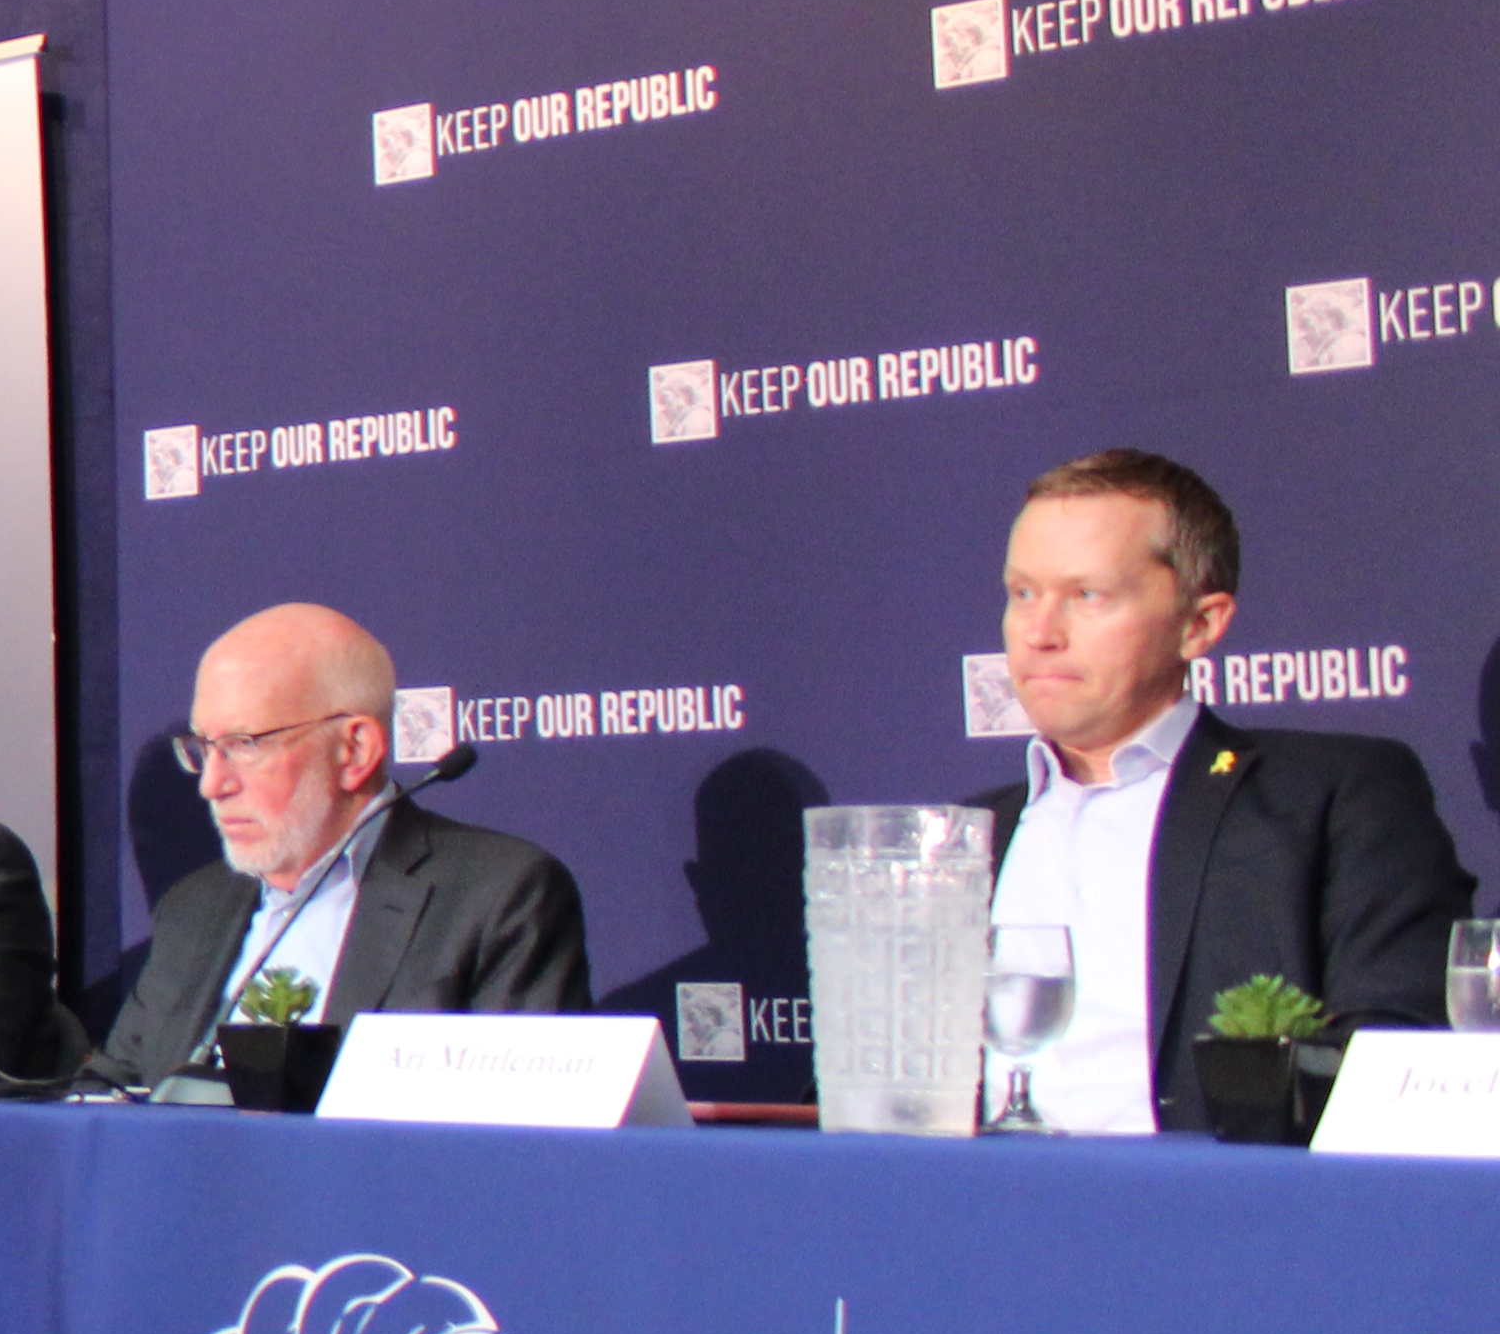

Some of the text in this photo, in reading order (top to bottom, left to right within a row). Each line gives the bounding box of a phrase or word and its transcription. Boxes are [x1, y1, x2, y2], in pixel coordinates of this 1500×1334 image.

[436, 66, 715, 156] KEEP OUR REPUBLIC
[1380, 281, 1483, 343] KEEP
[721, 336, 1036, 417] KEEP OUR REPUBLIC
[202, 407, 455, 476] KEEP OUR REPUBLIC
[1225, 645, 1407, 704] REPUBLIC
[457, 685, 742, 741] KEEP OUR REPUBLIC
